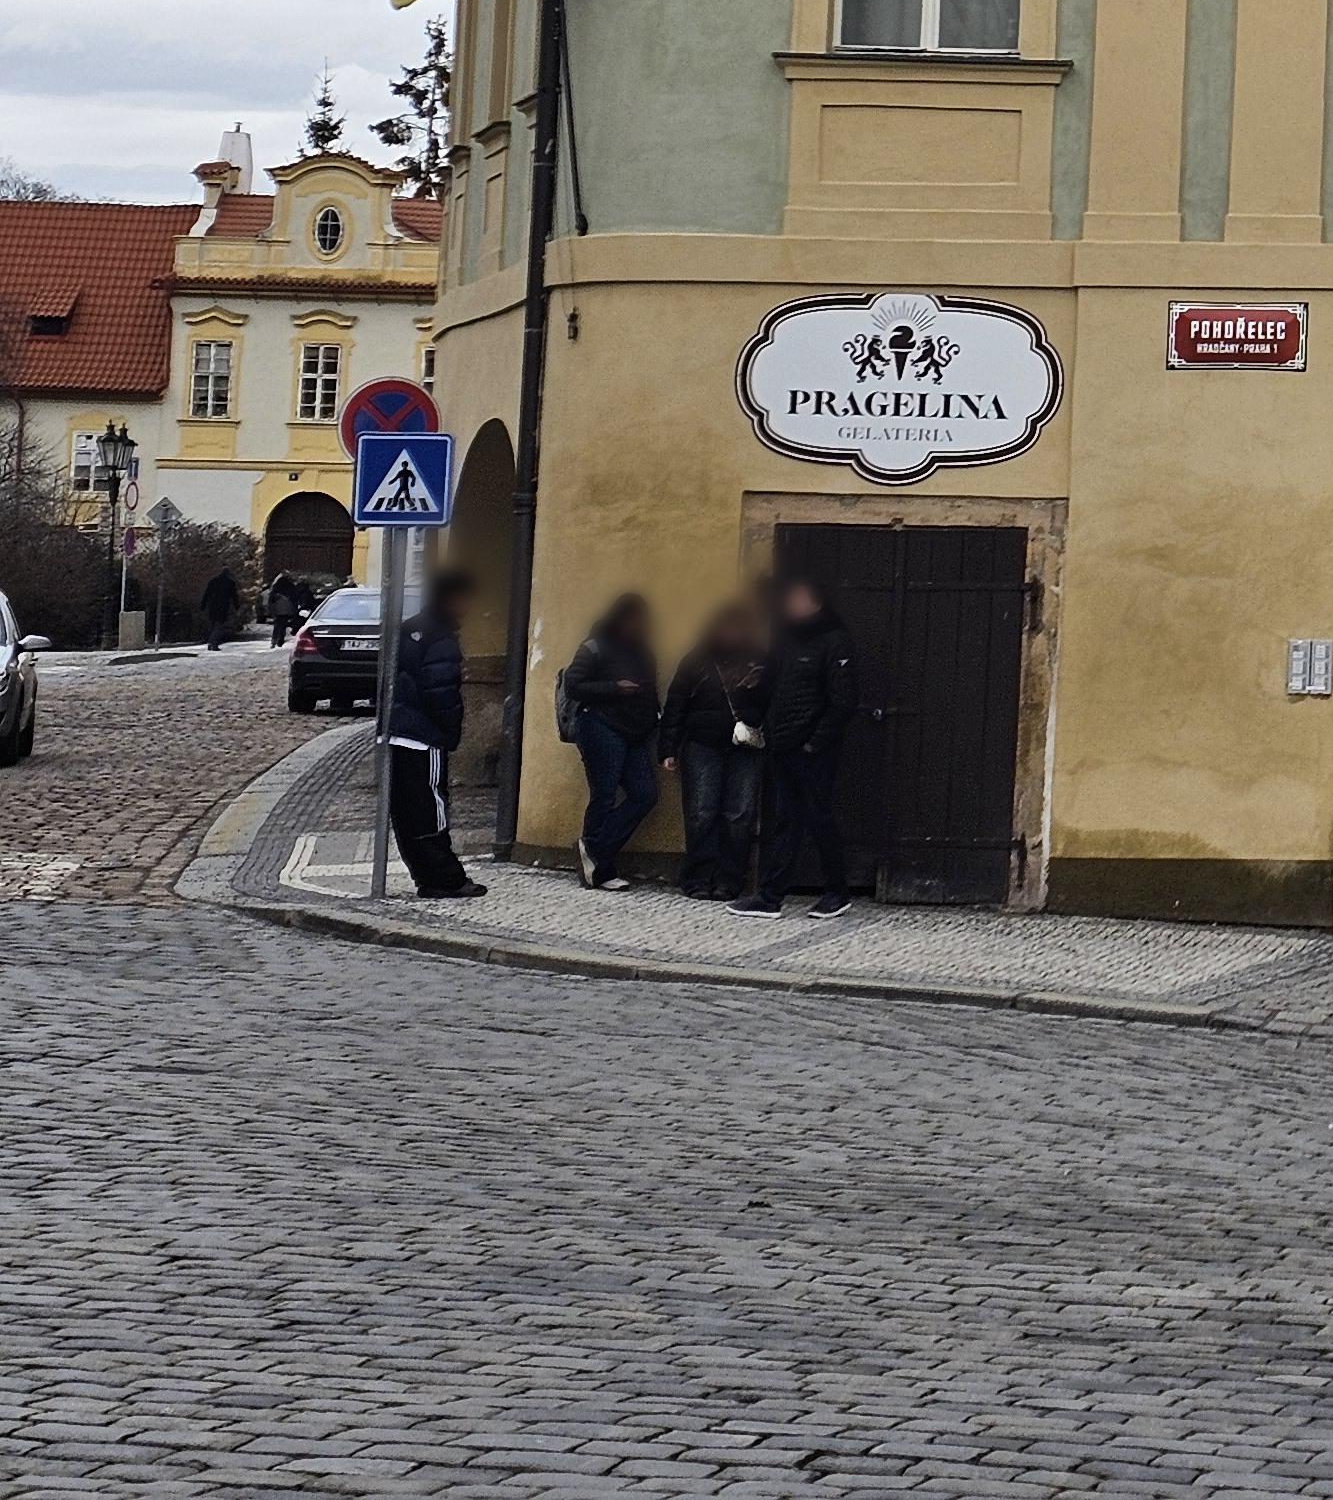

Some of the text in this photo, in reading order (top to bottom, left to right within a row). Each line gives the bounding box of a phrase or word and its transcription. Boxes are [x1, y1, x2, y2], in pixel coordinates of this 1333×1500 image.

[1190, 317, 1286, 340] POHOŘELEC
[1197, 341, 1240, 354] HRADČANY
[1243, 343, 1270, 354] PRAHA
[786, 389, 1008, 420] PRAGELINA
[838, 426, 954, 442] GELATERIA
